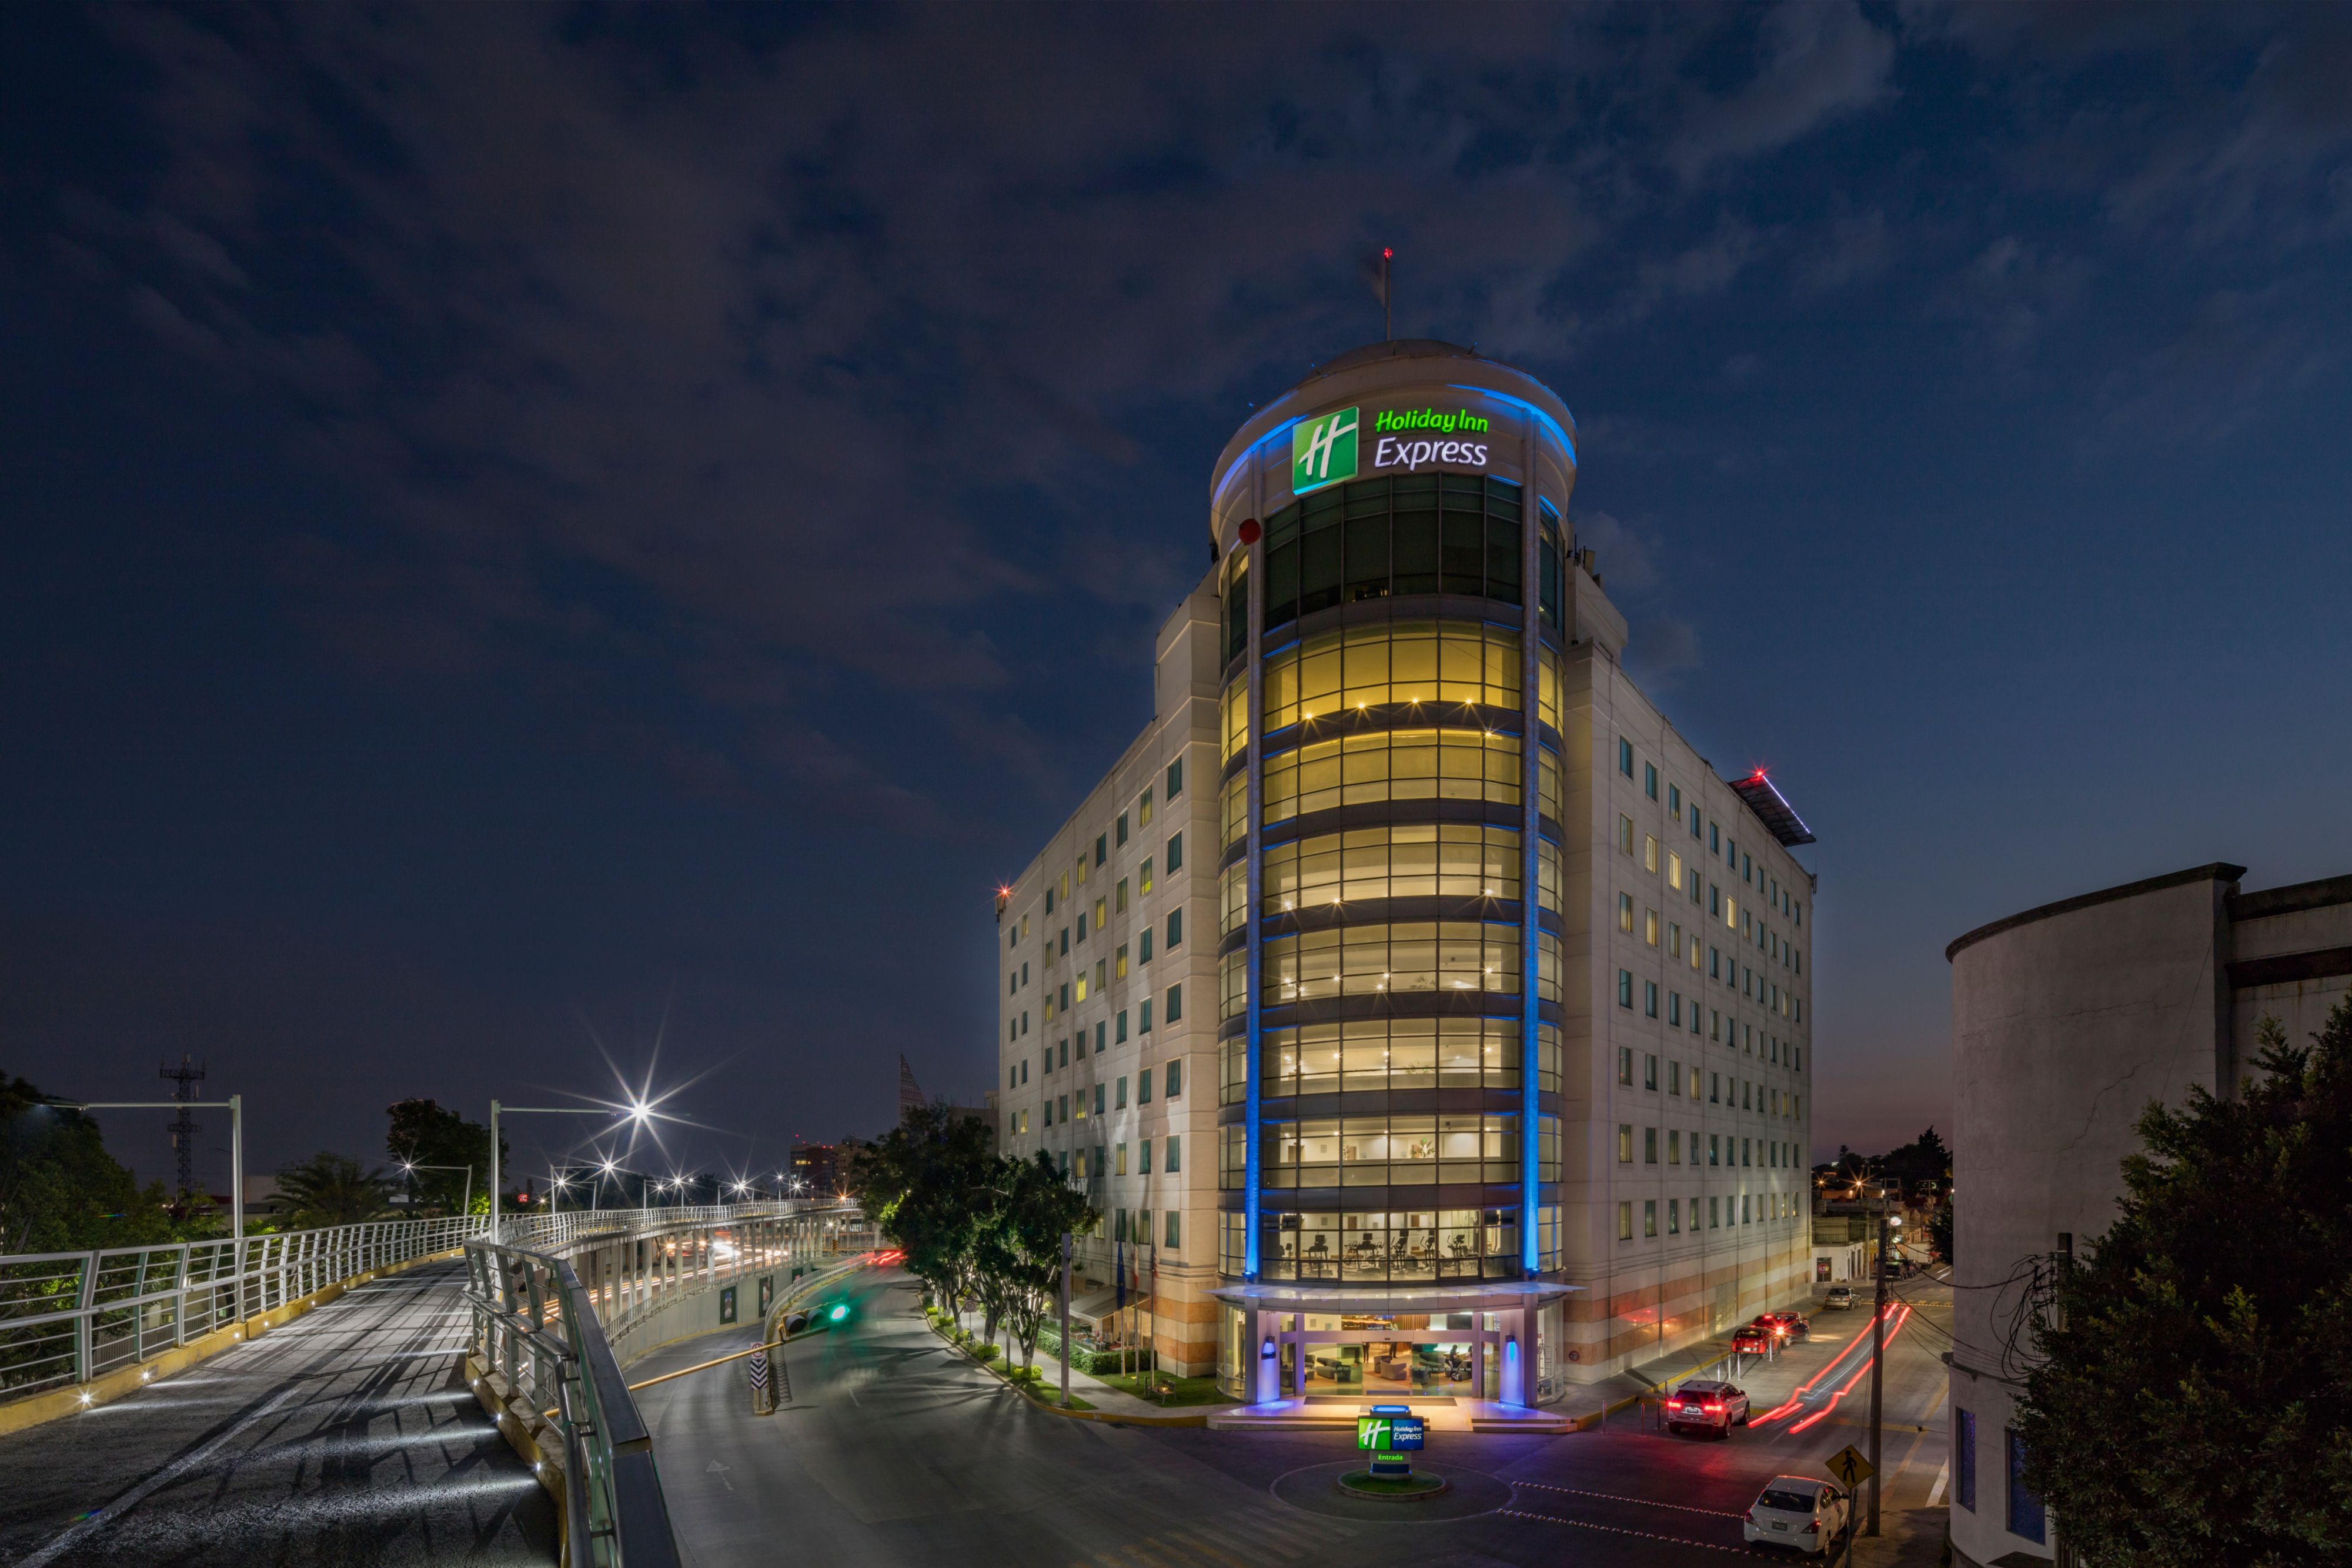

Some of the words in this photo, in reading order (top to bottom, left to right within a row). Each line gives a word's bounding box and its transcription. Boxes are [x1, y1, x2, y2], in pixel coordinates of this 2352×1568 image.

[1375, 408, 1456, 432] Holiday
[1458, 409, 1488, 433] Inn
[1375, 437, 1488, 471] Express
[1394, 1433, 1422, 1442] Express
